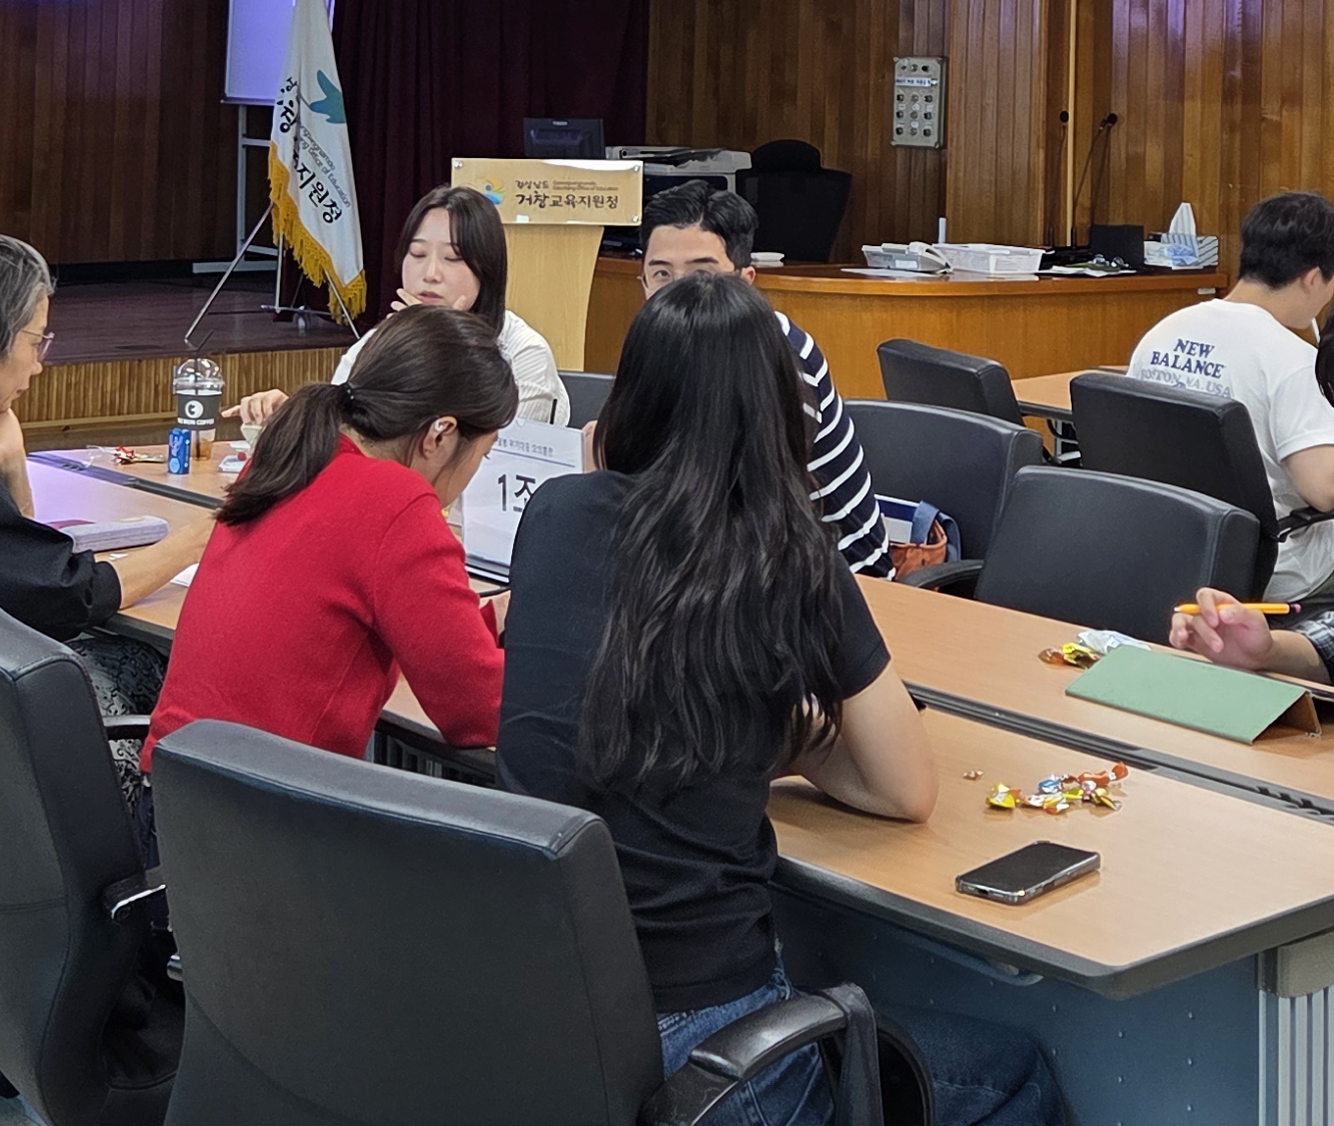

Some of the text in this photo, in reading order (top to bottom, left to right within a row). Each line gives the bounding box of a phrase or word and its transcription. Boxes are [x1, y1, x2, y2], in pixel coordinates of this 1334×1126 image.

[514, 190, 619, 210] 거창교육지원청
[1173, 338, 1216, 359] NEW
[1150, 350, 1225, 380] BALANCE
